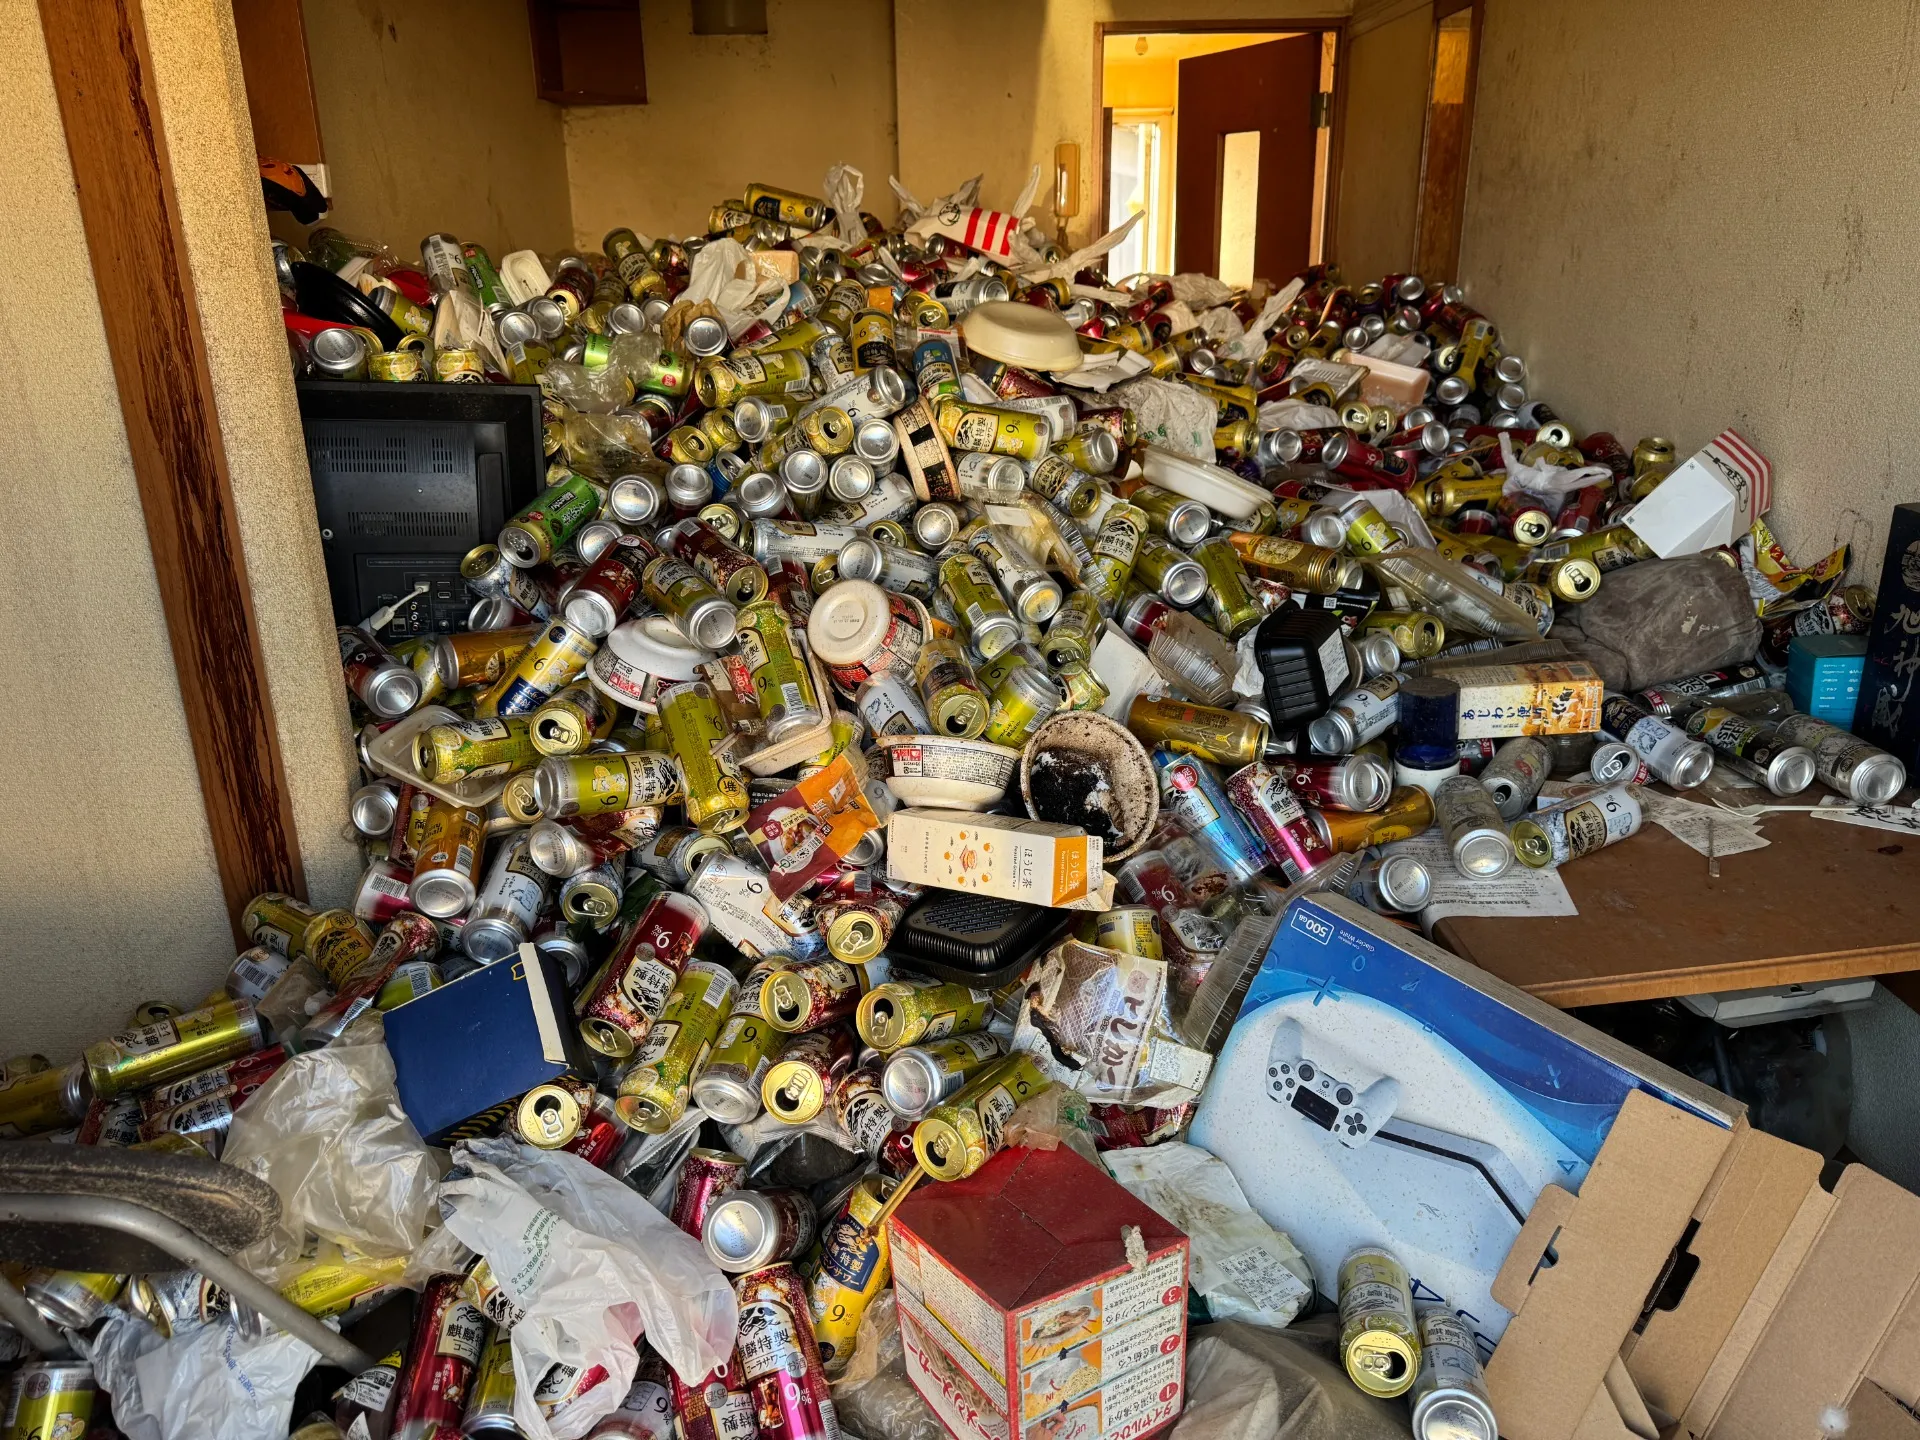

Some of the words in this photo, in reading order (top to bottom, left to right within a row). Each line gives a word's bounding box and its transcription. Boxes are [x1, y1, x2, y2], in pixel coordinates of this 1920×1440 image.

[758, 676, 768, 693] 9
[1461, 703, 1548, 720] あじわい便り
[746, 879, 763, 894] 9
[655, 932, 670, 949] 9
[743, 1026, 757, 1043] 9
[1017, 1081, 1031, 1096] 9
[1166, 1290, 1178, 1304] 3
[829, 1304, 845, 1322] 9
[1166, 1338, 1177, 1352] 2
[784, 1382, 800, 1411] 9
[1164, 1384, 1172, 1399] 1
[655, 1396, 669, 1412] 9
